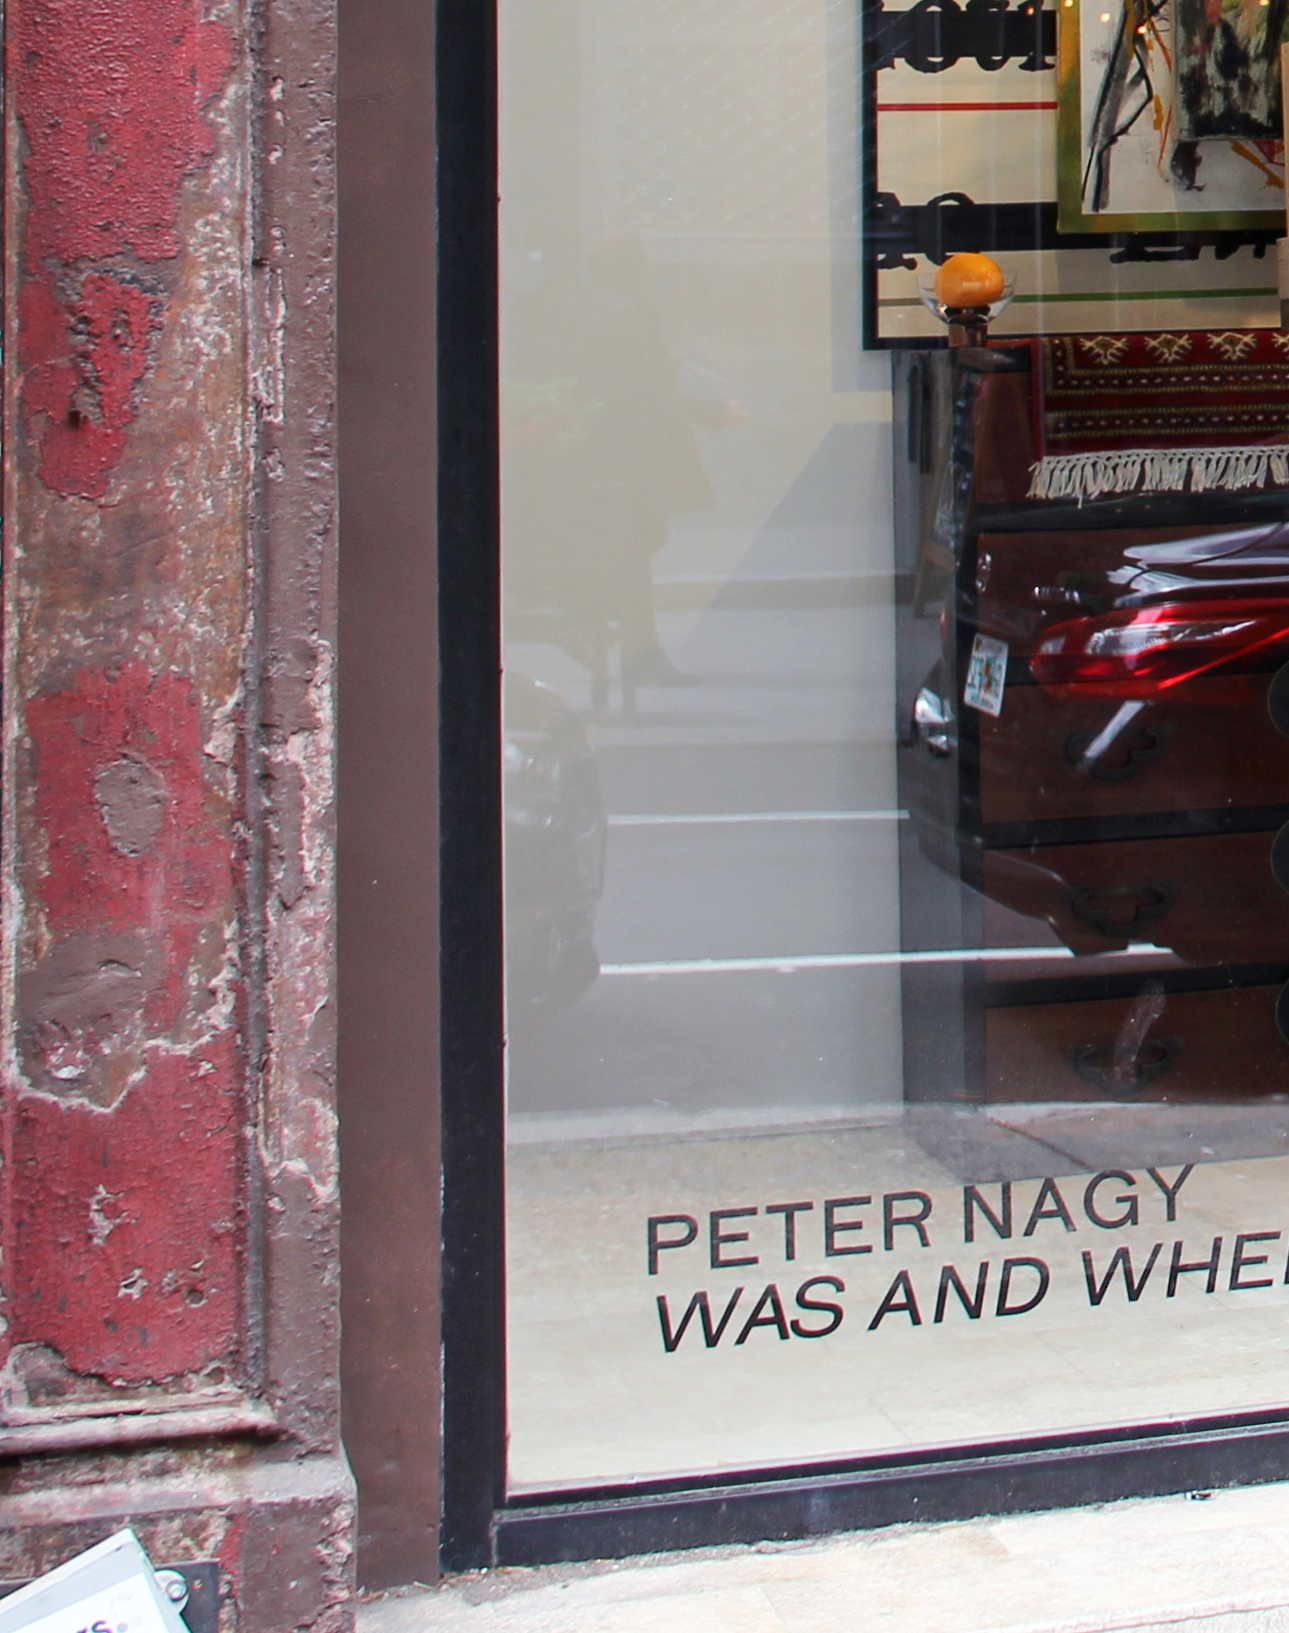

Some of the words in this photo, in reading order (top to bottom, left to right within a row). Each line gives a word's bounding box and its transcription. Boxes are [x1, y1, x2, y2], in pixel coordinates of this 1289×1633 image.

[647, 1190, 933, 1276] PETER
[963, 1163, 1196, 1243] NAGY
[655, 1275, 846, 1353] WAS
[867, 1257, 1051, 1331] AND
